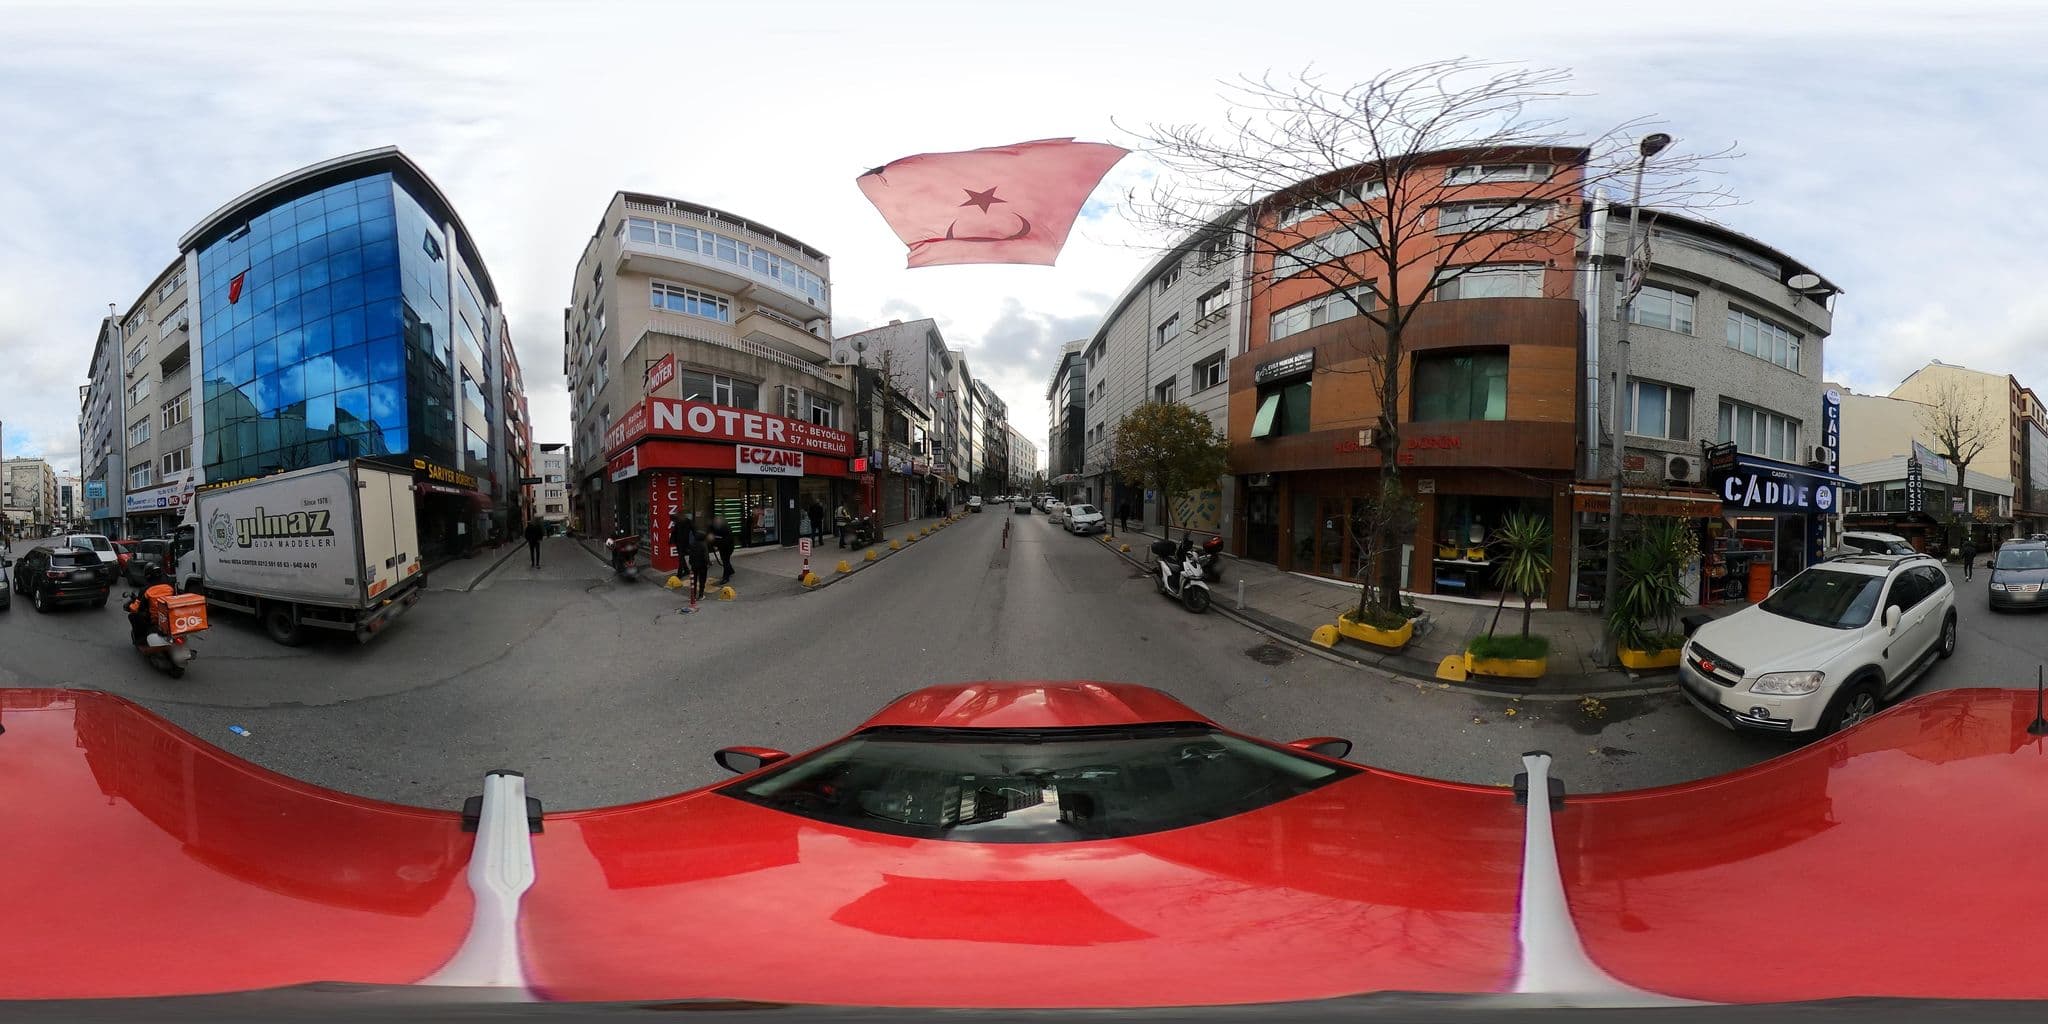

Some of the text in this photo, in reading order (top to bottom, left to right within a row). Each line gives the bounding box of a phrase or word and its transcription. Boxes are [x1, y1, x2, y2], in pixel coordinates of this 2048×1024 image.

[651, 363, 672, 389] NOTER
[653, 401, 786, 443] NOTER
[790, 422, 846, 442] T.C. BEYOĞLU
[604, 423, 626, 453] NOTER
[790, 435, 847, 453] 57. NOTERLİĞİ
[740, 447, 802, 468] ECZANE
[759, 465, 786, 474] GÜNDEM
[1725, 474, 1809, 507] CADDE
[236, 507, 334, 548] yılmaz
[667, 477, 679, 557] ECZAE
[255, 537, 336, 548] GIDA MADDELERİ
